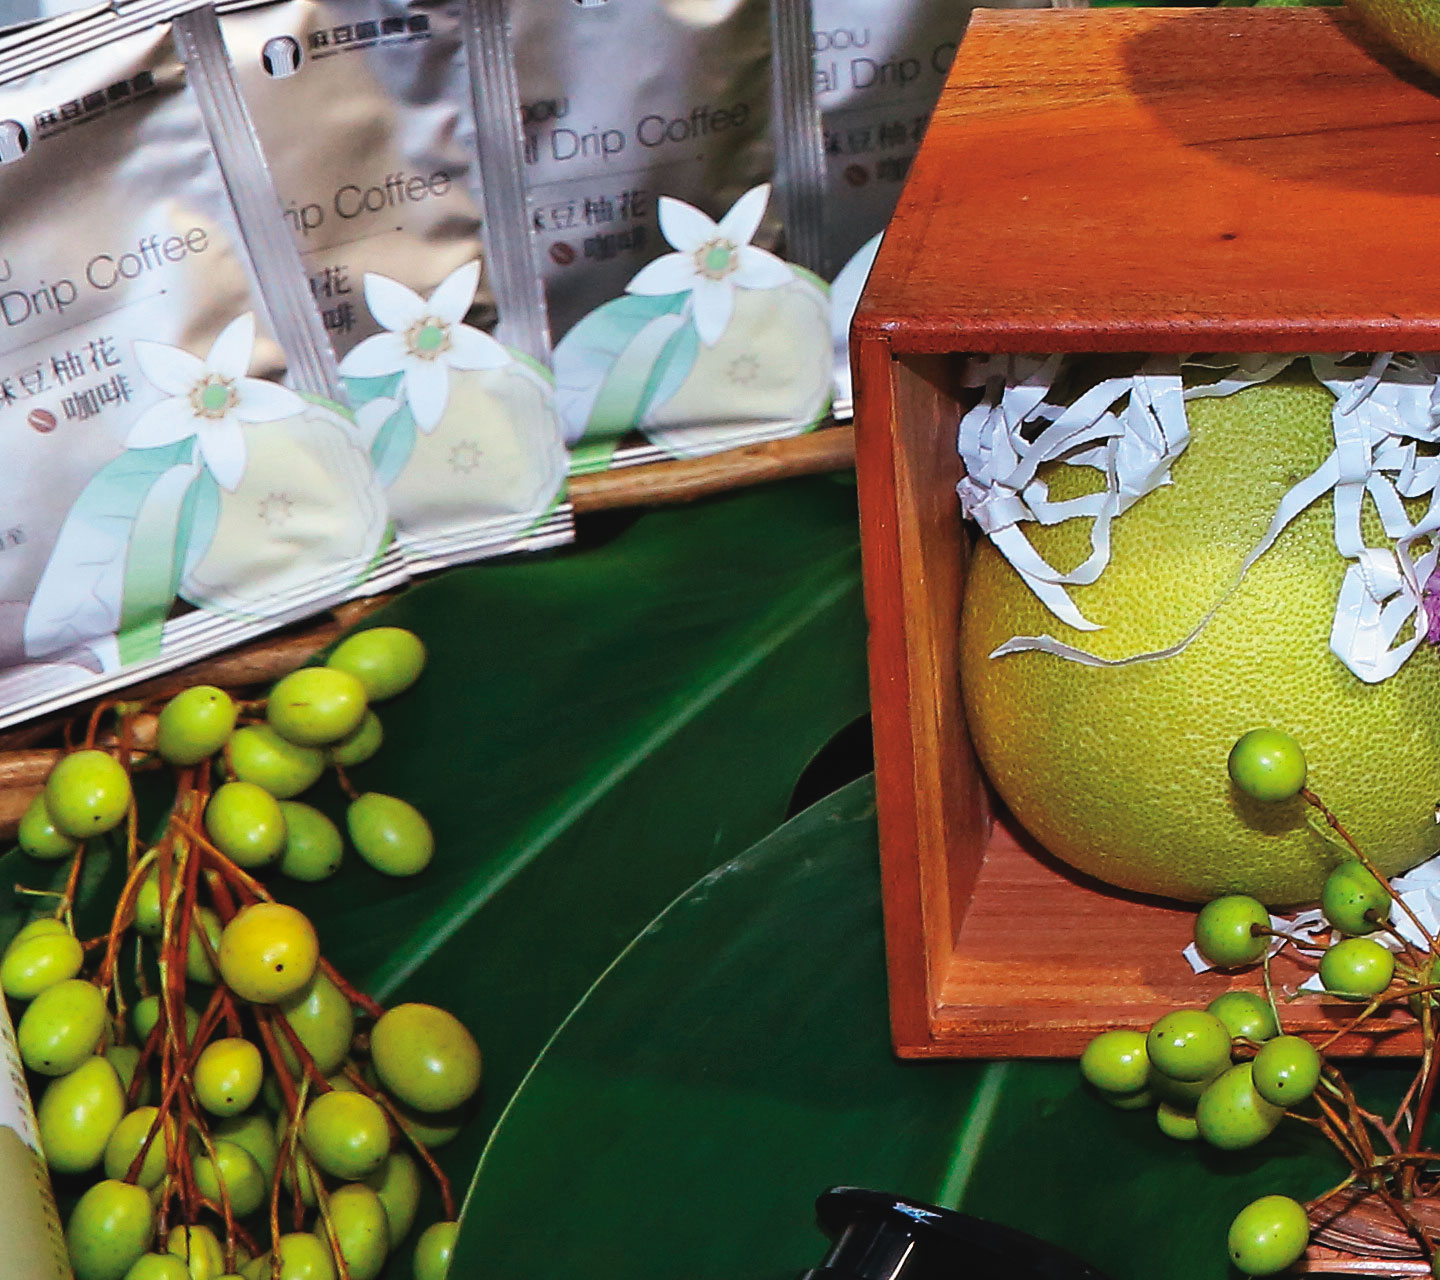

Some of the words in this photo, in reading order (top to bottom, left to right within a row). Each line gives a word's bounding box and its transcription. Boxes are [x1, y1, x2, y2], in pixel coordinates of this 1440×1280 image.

[551, 125, 627, 165] Drip
[636, 102, 750, 148] Coffee
[334, 170, 453, 219] Coffee
[0, 279, 78, 328] Drip
[86, 227, 209, 290] Coffee
[60, 373, 134, 422] 咖啡
